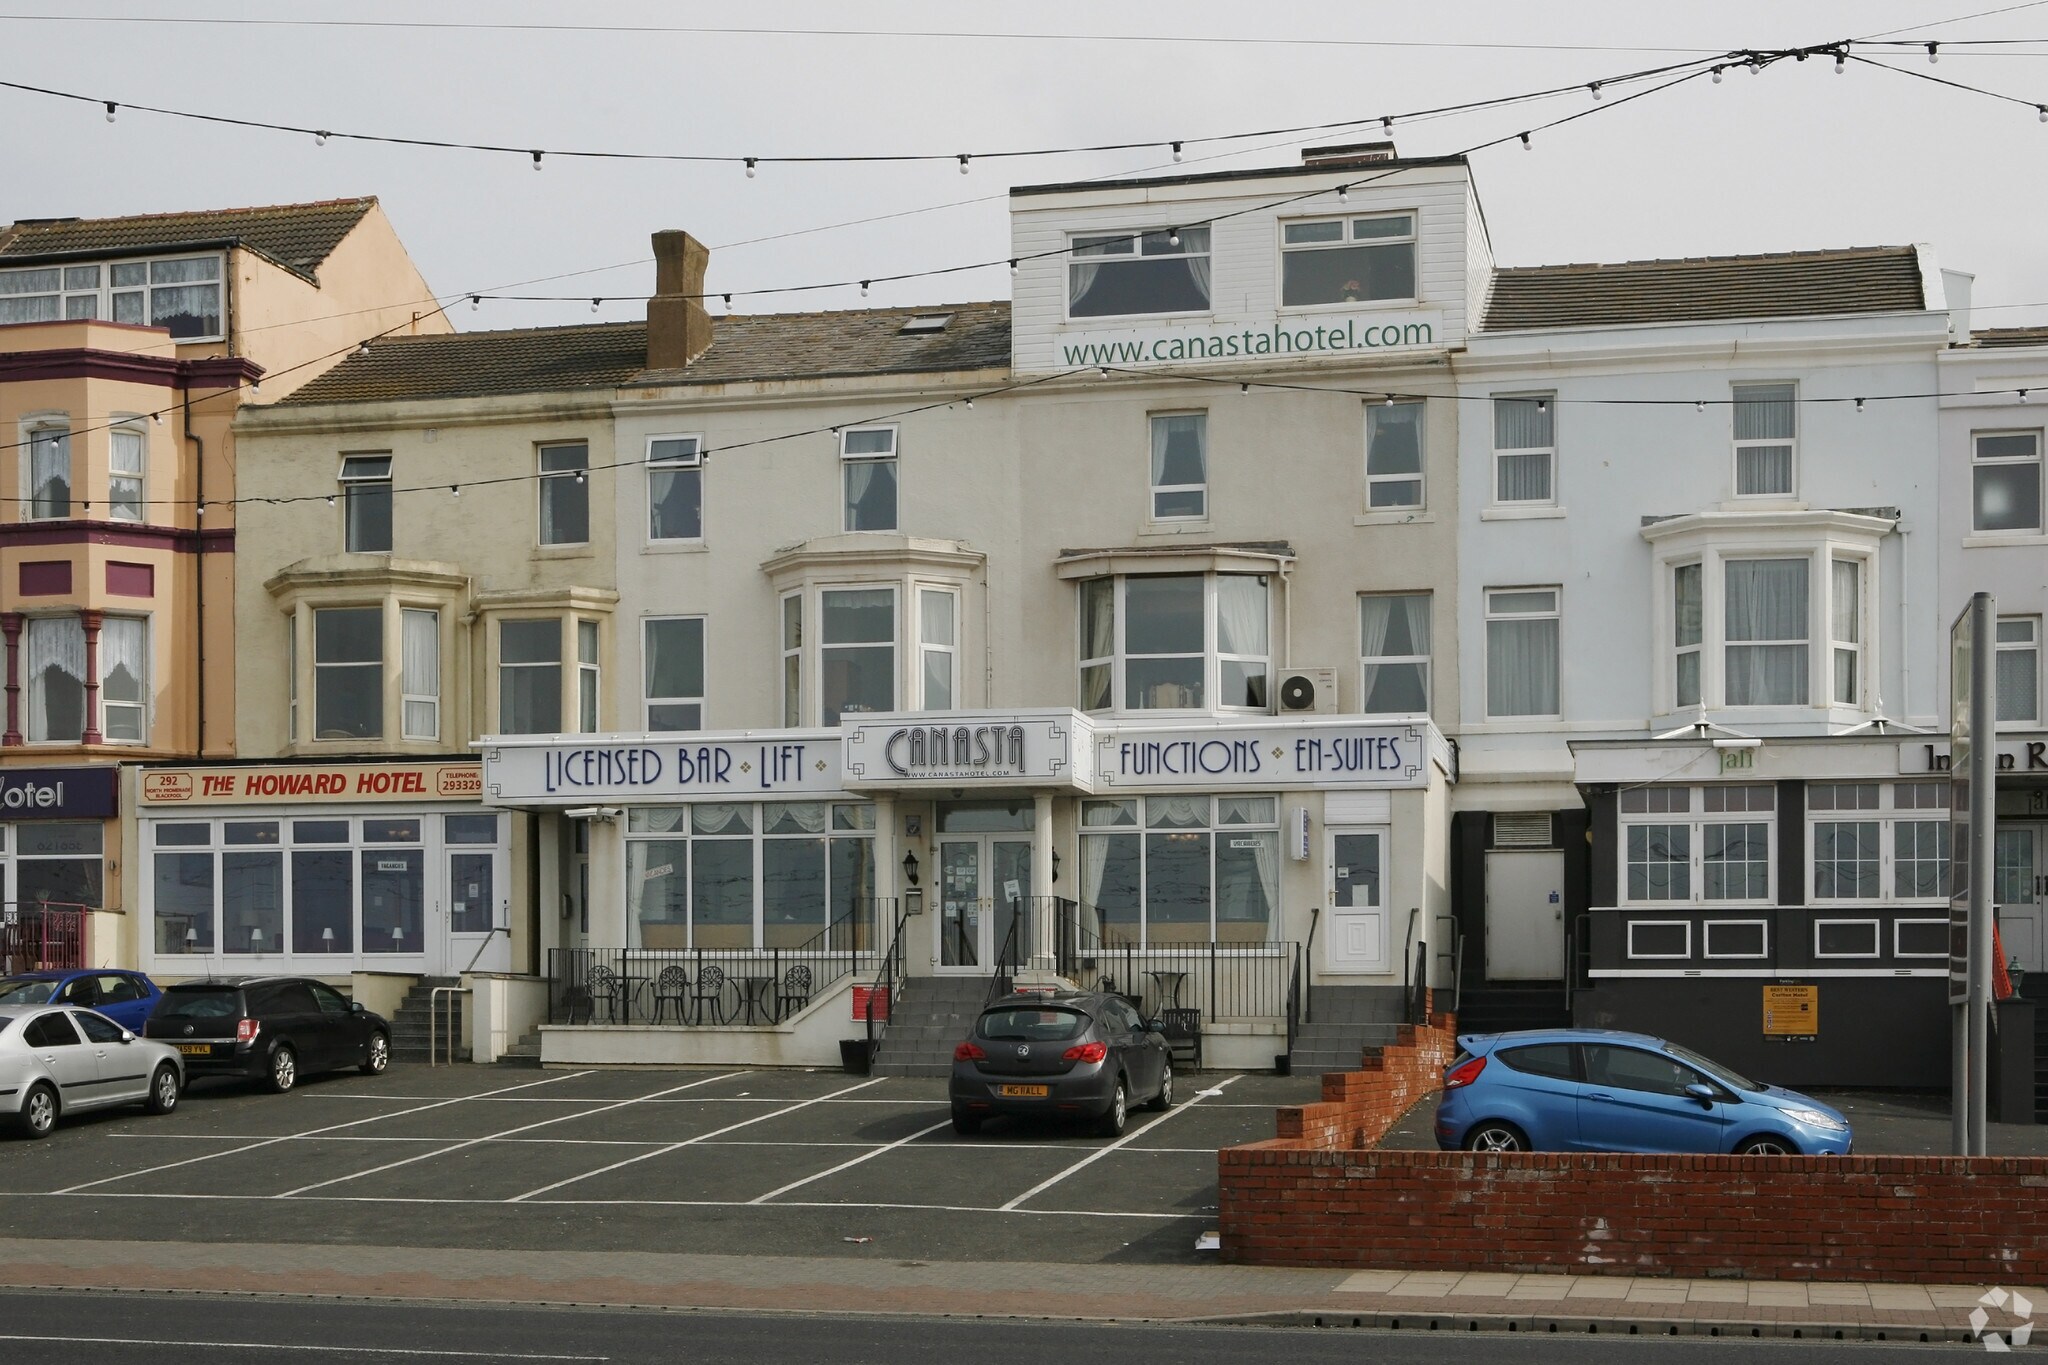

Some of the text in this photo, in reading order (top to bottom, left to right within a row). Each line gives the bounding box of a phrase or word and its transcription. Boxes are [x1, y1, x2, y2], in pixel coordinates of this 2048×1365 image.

[1063, 320, 1432, 365] www.canastahotel.com
[885, 725, 1026, 774] CANASTA
[1121, 737, 1401, 775] FUNCTIONS EN-SUITES
[160, 776, 178, 786] 292
[202, 772, 427, 797] THE HOWARD HOTEL
[546, 745, 805, 792] LICENSED BAR LIFT
[904, 770, 1010, 778] WWW.CANASTAHOTEL.COM
[0, 776, 64, 808] otel
[443, 780, 482, 791] 293329
